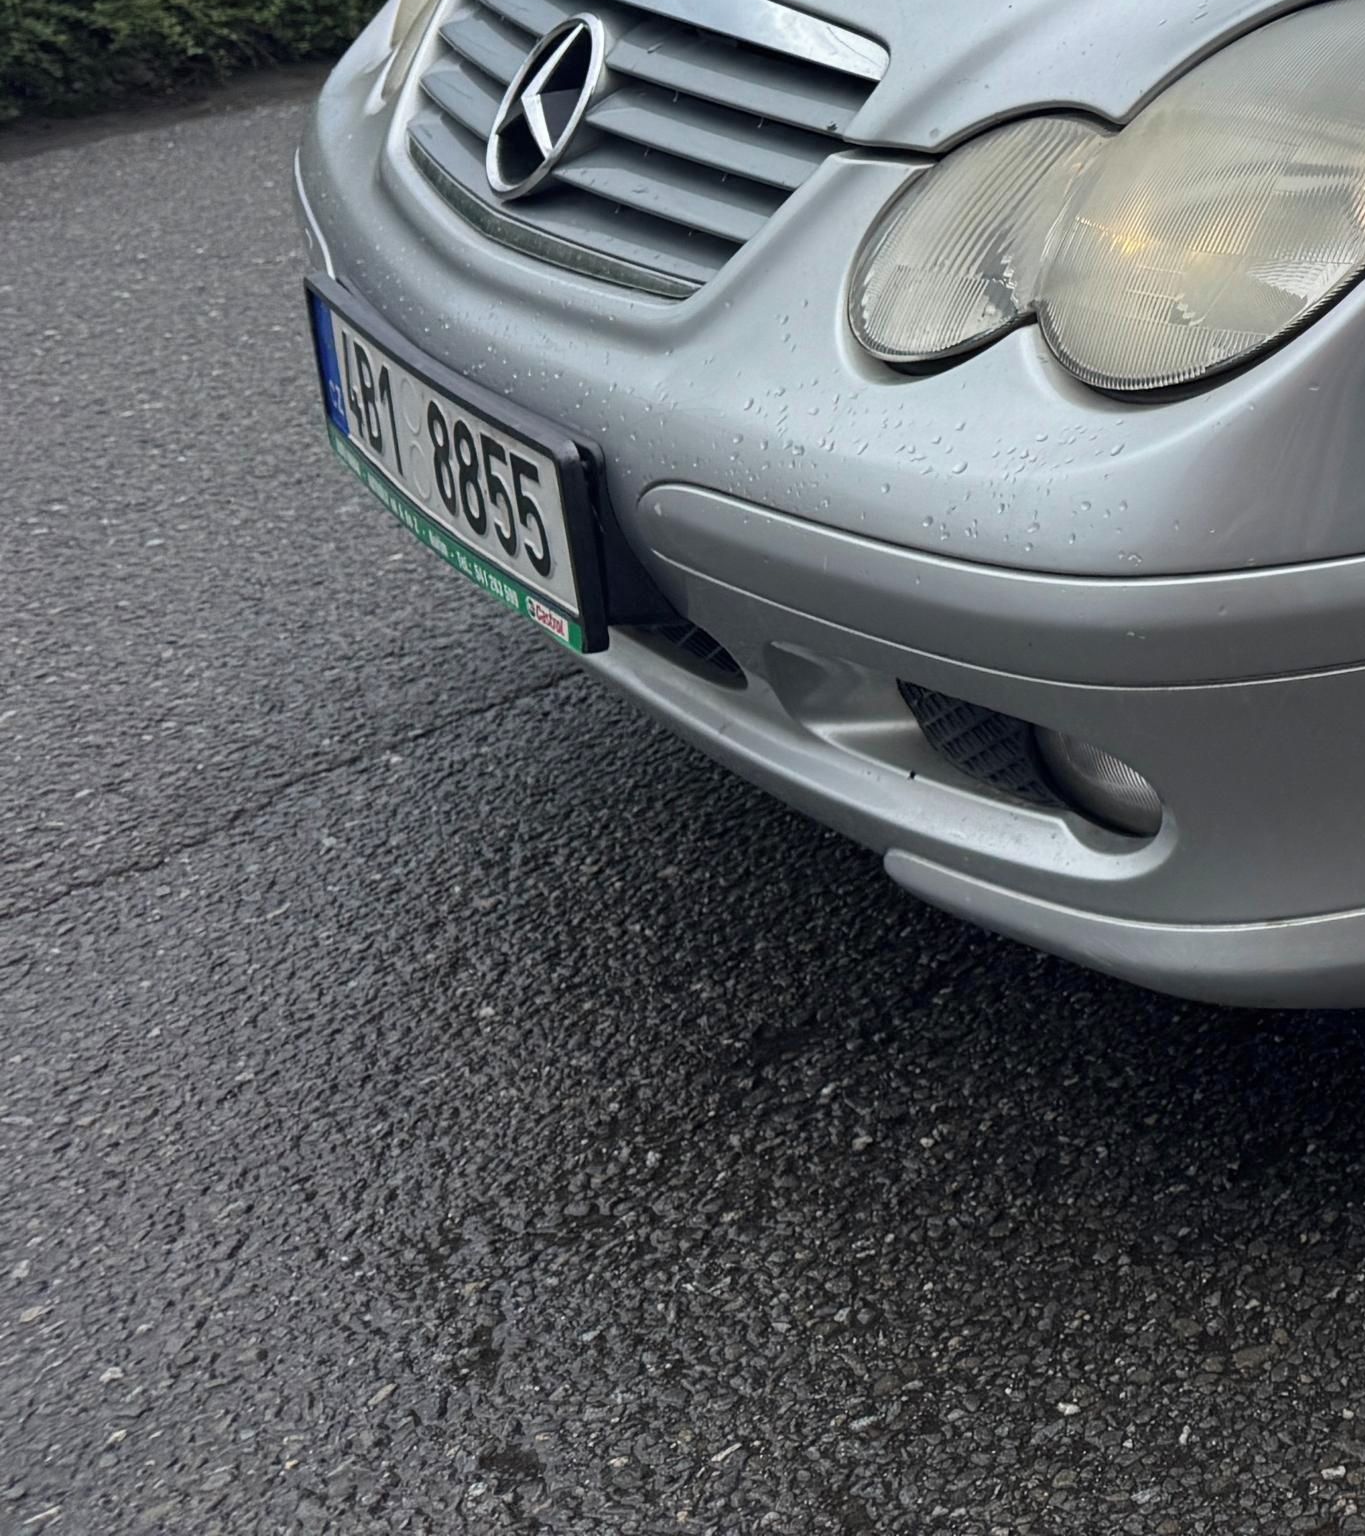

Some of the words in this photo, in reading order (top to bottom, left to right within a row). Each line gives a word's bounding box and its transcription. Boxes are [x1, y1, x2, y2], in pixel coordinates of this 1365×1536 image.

[341, 330, 403, 477] 4B1
[427, 399, 552, 578] 8855
[535, 604, 566, 637] Castrol
